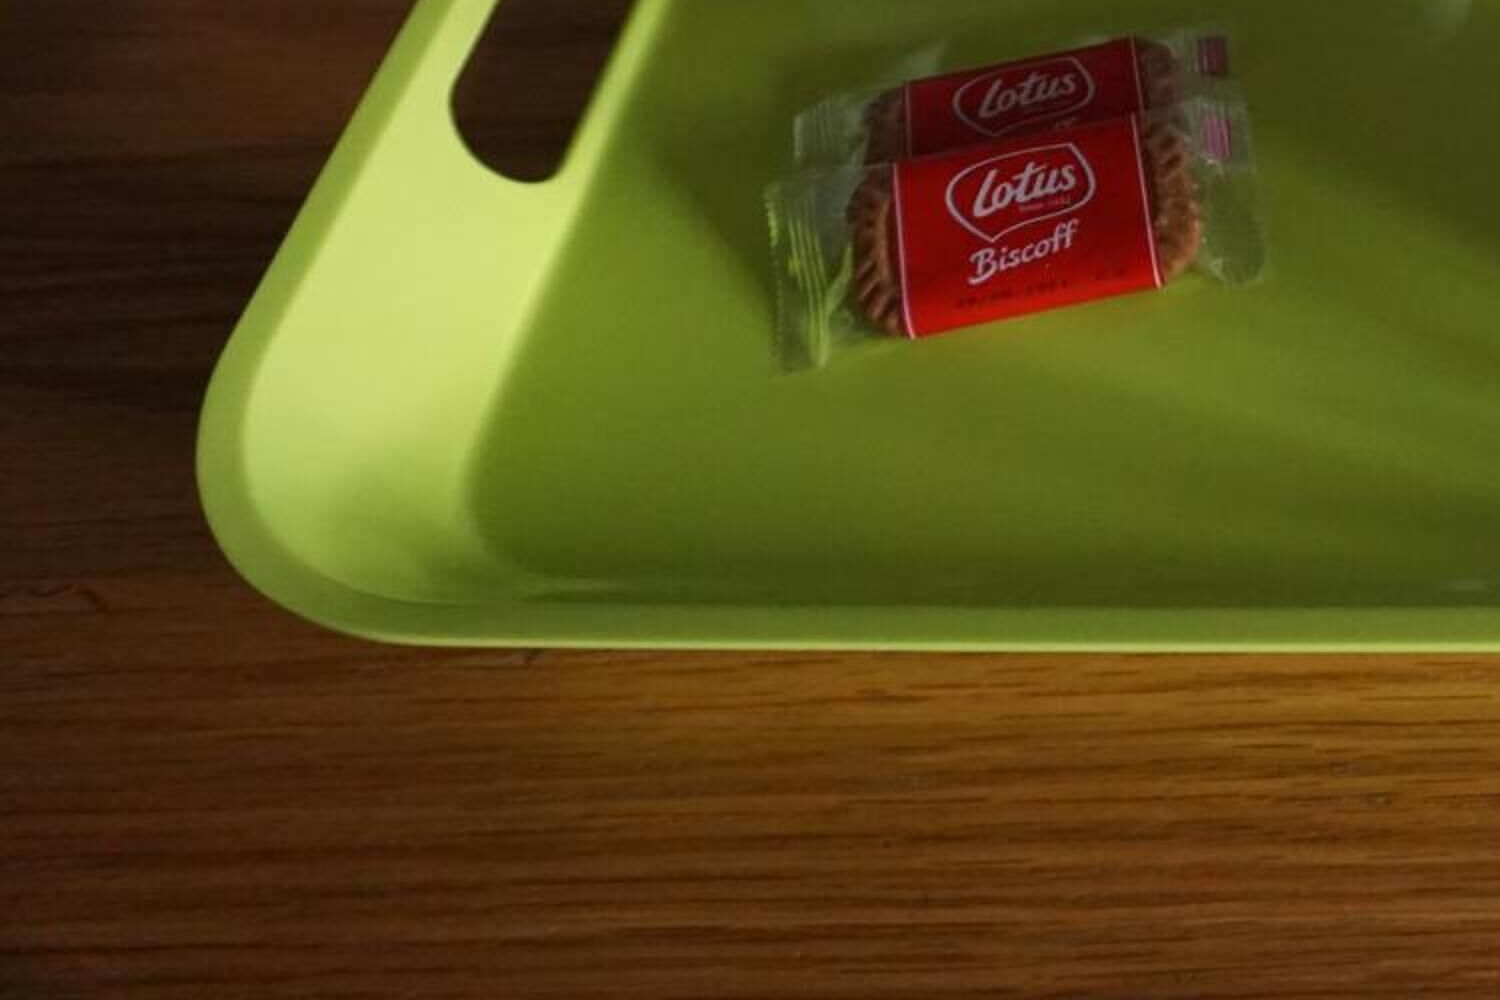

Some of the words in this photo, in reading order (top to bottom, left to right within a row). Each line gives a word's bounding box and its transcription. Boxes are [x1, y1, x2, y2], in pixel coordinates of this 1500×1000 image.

[978, 71, 1078, 119] Lotus
[972, 161, 1077, 218] Lotus
[967, 217, 1080, 286] Biscoff
